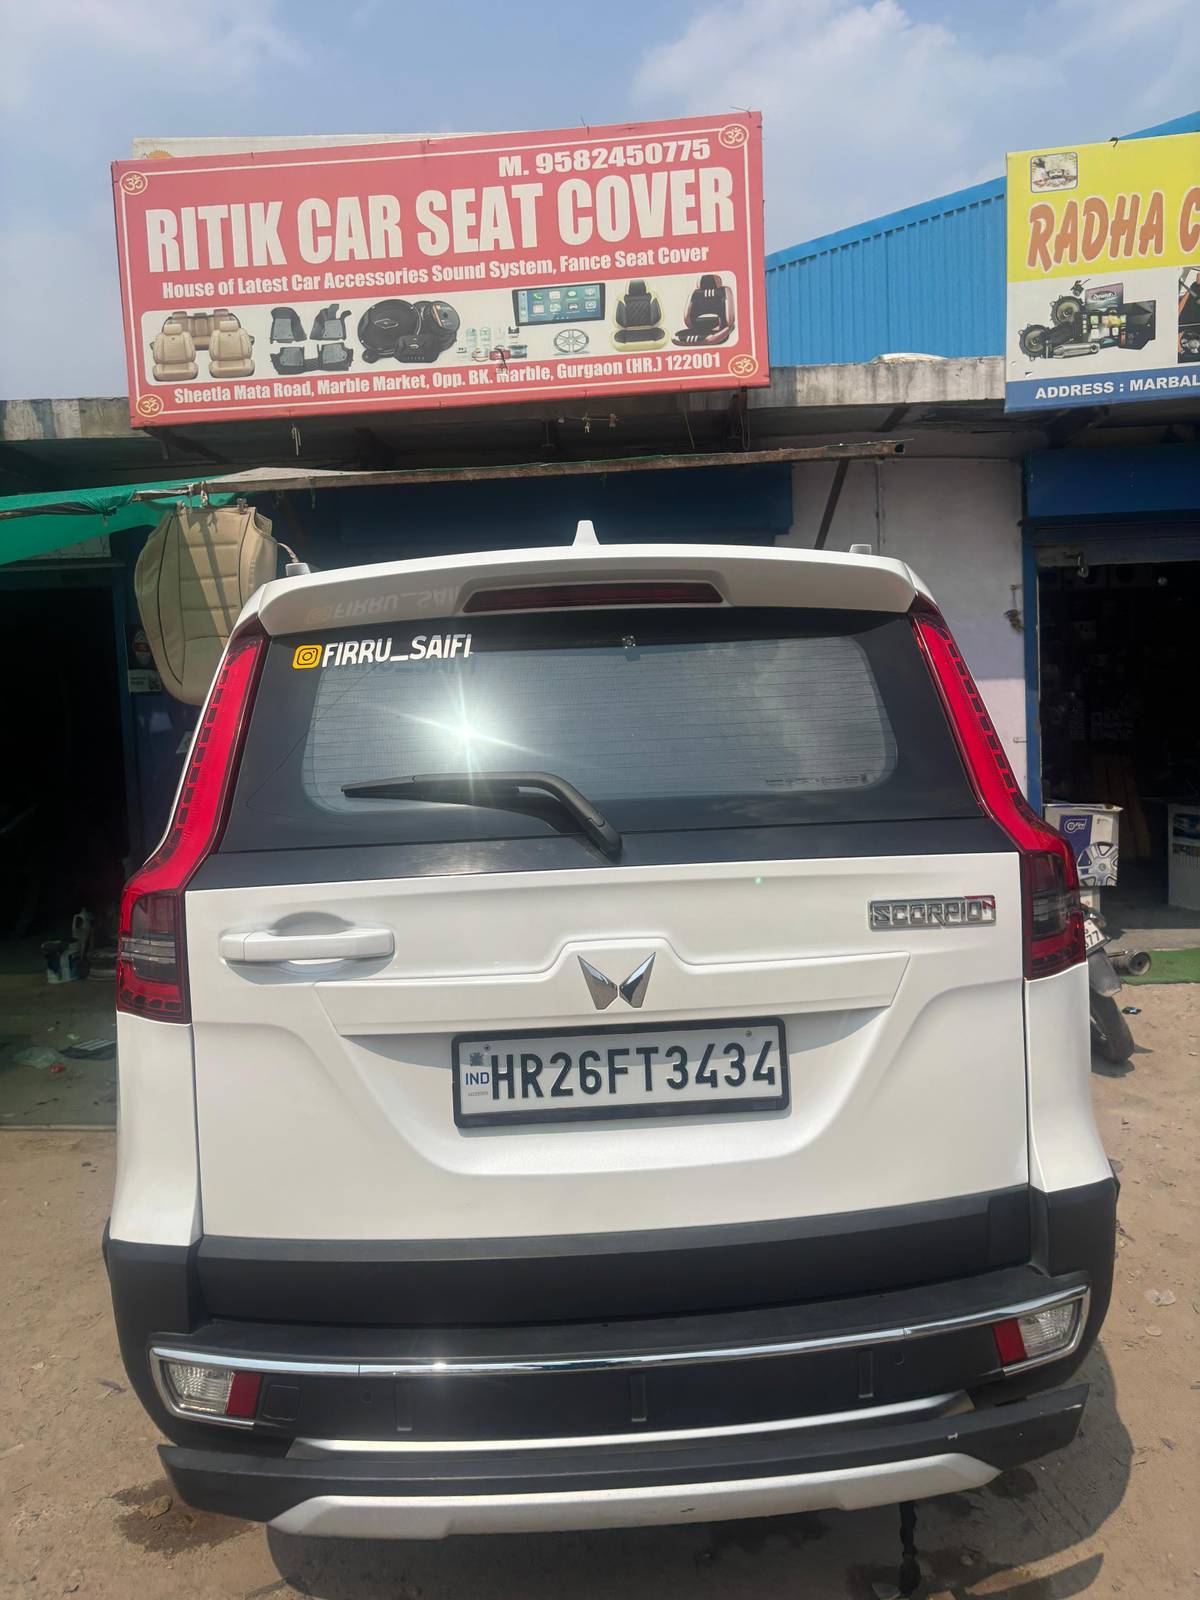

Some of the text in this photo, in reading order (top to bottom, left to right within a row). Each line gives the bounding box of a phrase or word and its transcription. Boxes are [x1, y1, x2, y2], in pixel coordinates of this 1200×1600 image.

[498, 138, 710, 177] M. 9582450775
[145, 166, 735, 273] RITIK CAR SEAT COVER
[1027, 190, 1165, 272] RADHA
[162, 245, 710, 299] House of Latest Car Accessories Sound System, Fance Seat Cover
[174, 384, 231, 404] Sheetla
[234, 382, 271, 401] Mata
[273, 380, 315, 400] Road,
[317, 376, 370, 396] Marble
[373, 373, 430, 392] Market,
[433, 371, 466, 391] Opp.
[468, 364, 493, 385] BK.
[496, 361, 555, 384] Marble,
[557, 358, 624, 381] Gurgaon
[665, 352, 721, 371] 122001
[1035, 381, 1114, 400] ADDRESS
[321, 633, 473, 668] FIRRU_SAIFI
[465, 1040, 777, 1101] HR26FT3434 IND
